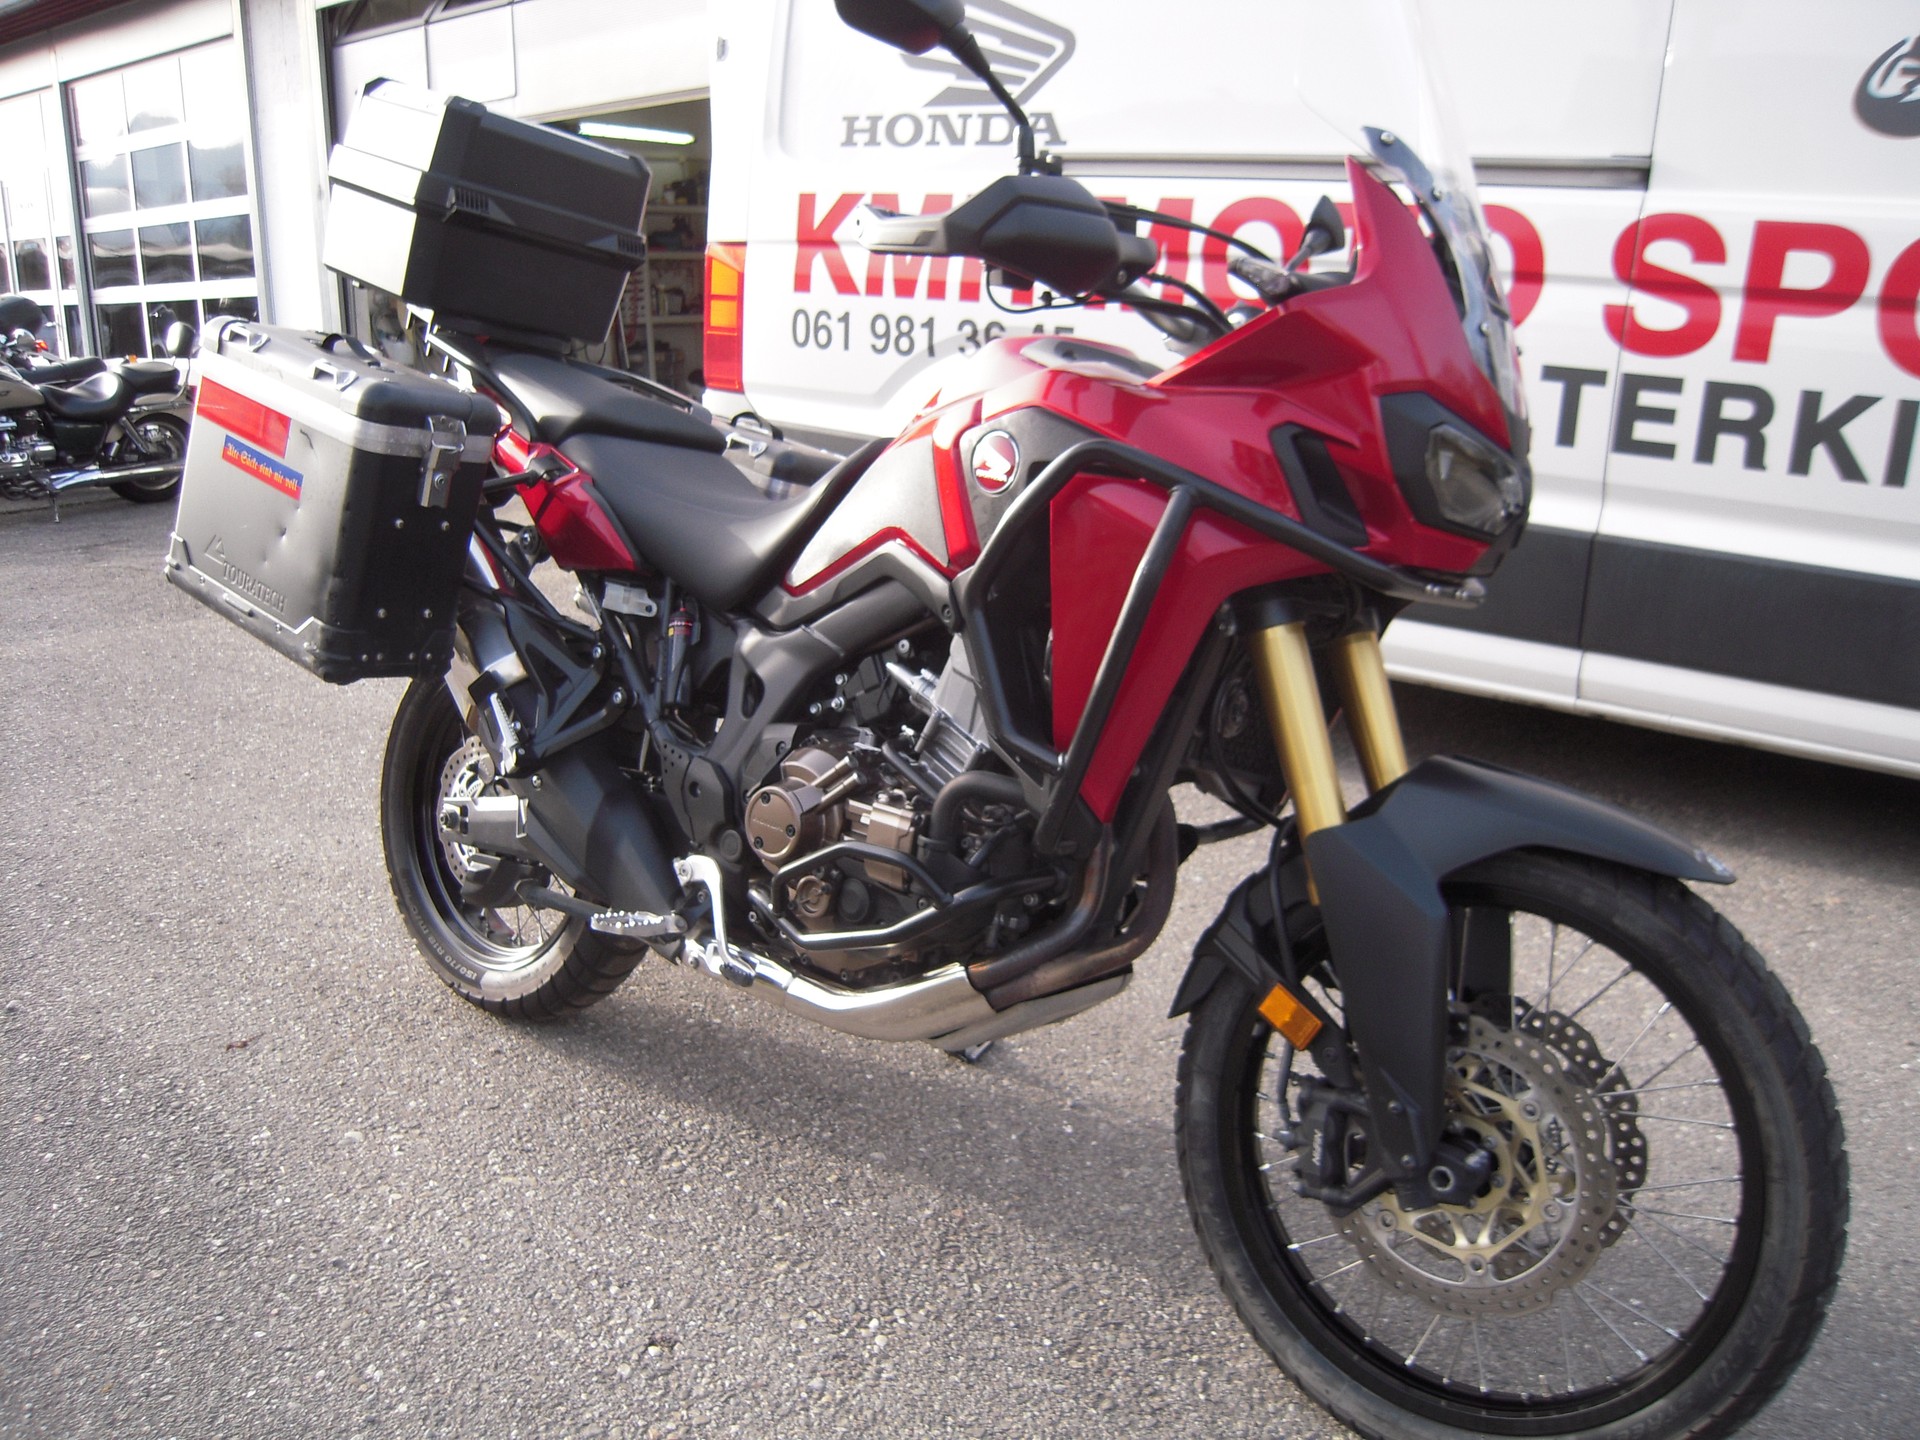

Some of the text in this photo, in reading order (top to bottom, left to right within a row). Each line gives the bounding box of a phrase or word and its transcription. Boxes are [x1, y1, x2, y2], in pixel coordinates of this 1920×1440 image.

[840, 112, 1067, 148] HONDA
[792, 308, 852, 351] 061
[870, 313, 936, 358] 981
[223, 560, 288, 614] TOURATECH
